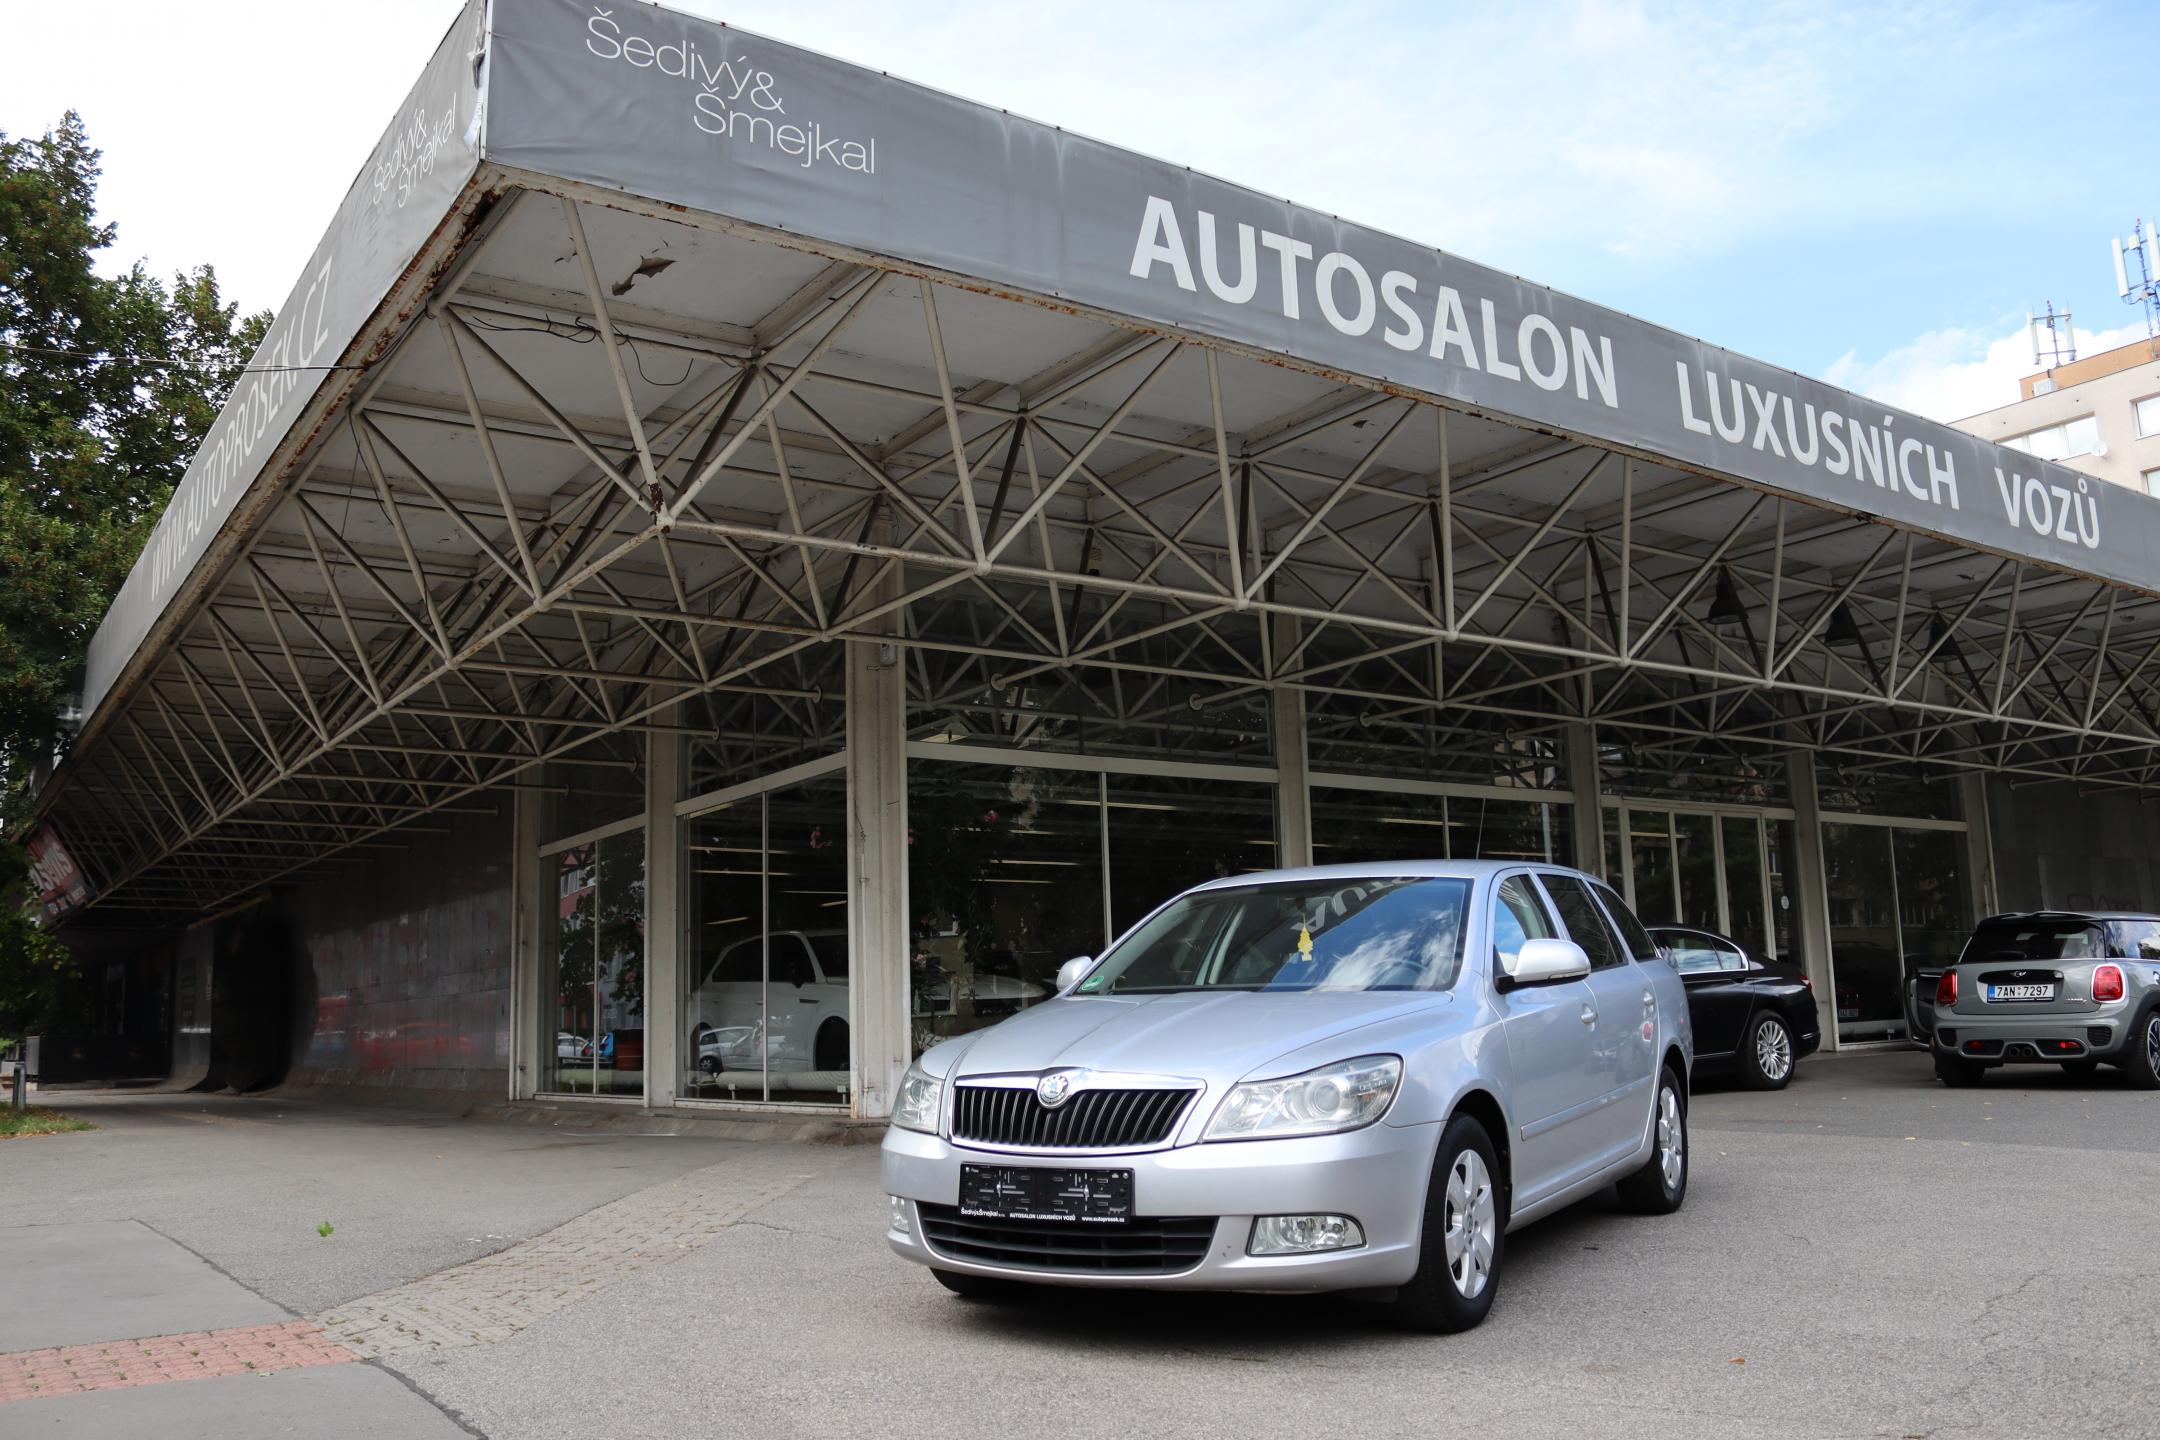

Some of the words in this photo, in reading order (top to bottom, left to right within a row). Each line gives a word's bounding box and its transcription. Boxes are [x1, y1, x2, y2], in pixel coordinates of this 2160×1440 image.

[586, 6, 785, 114] Šedivý&
[398, 91, 456, 208] Šmejkal
[693, 83, 875, 174] Šmejkal
[1129, 195, 1619, 409] AUTOSALON
[1676, 361, 1959, 510] LUXUSNÍCH
[1994, 466, 2100, 550] VOZŮ
[152, 255, 332, 601] WWW.AUTOPROSEK.CZ
[1996, 986, 2016, 999] 7AN
[2023, 985, 2049, 998] 7297
[1009, 1212, 1036, 1220] AUTOSALON
[1063, 1213, 1076, 1221] VOZŮ
